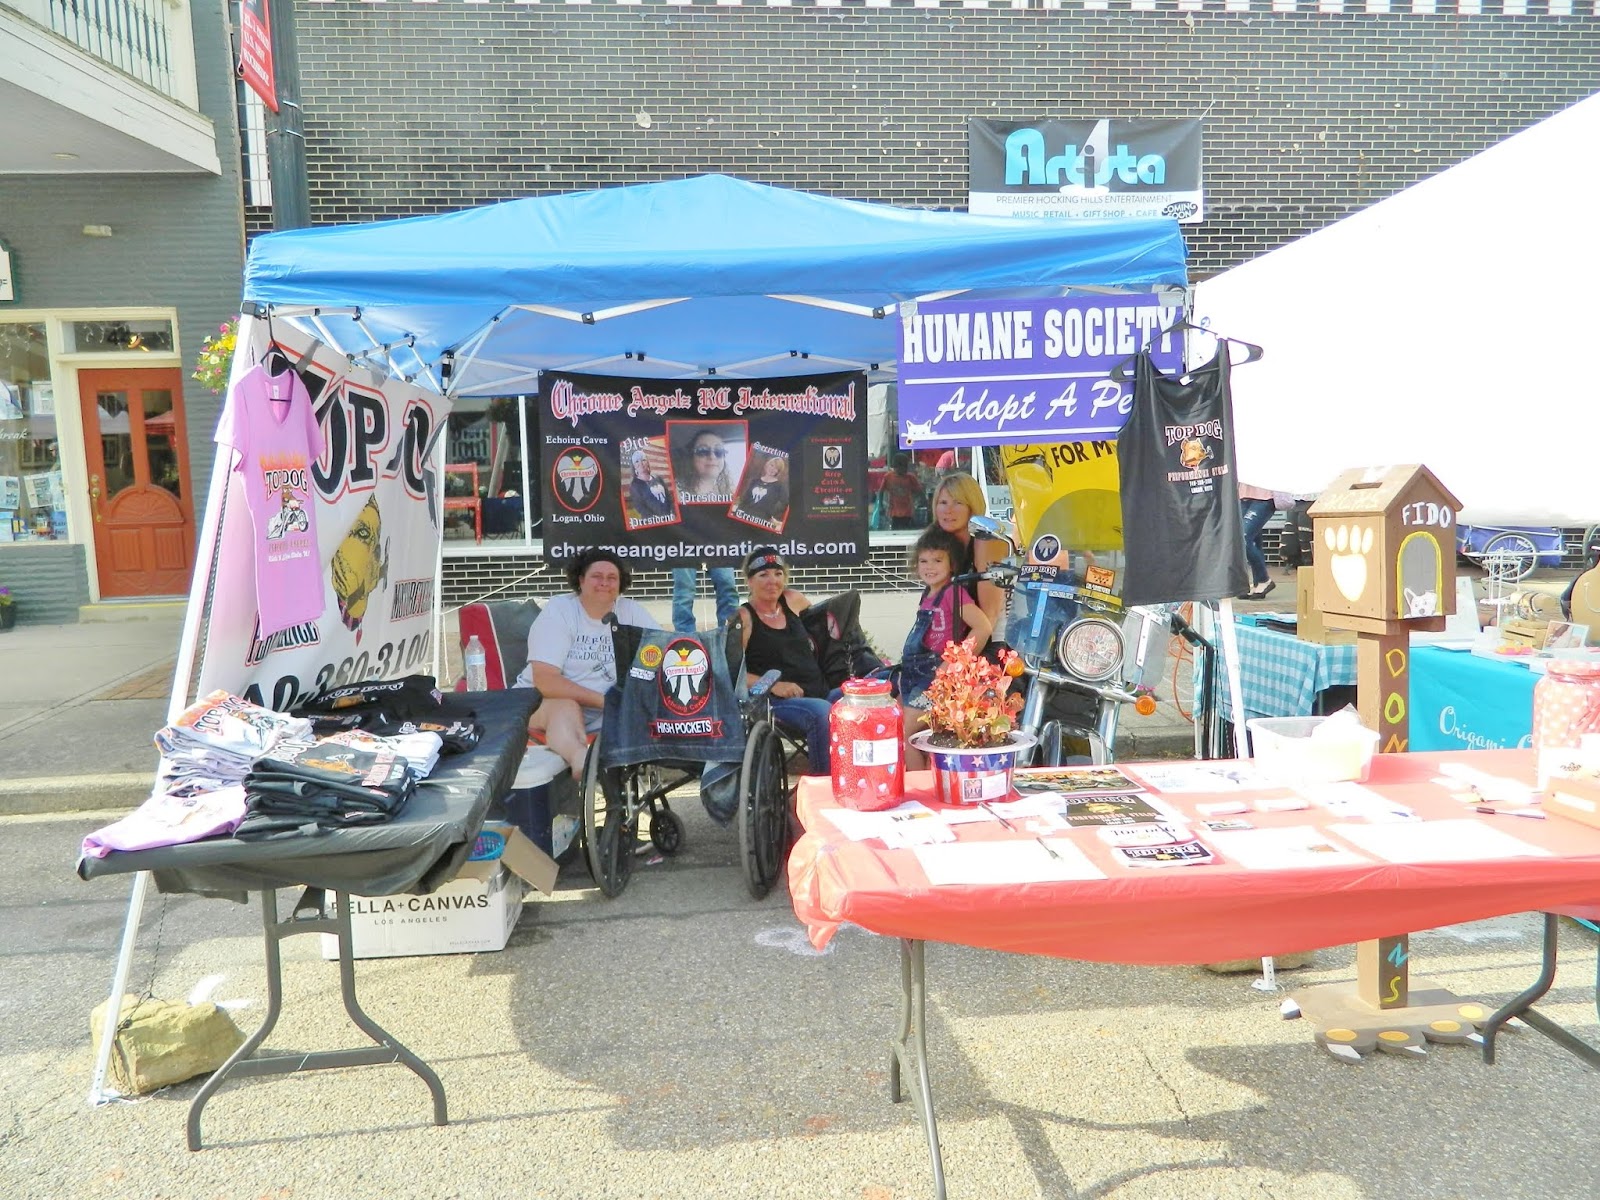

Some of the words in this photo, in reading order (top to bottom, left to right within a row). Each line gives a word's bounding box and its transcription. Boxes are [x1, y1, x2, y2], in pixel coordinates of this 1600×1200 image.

[1005, 128, 1165, 188] Artista
[996, 195, 1034, 204] PREMIER
[1036, 195, 1079, 204] HOCKING
[1081, 195, 1103, 203] HILLS
[1105, 194, 1172, 203] ENTERTAINMENT
[1163, 201, 1196, 213] COMING
[1012, 210, 1039, 218] MUSIC
[1044, 210, 1072, 218] RETAIL
[1083, 210, 1100, 218] GIFT
[1103, 210, 1125, 218] SHOP
[1136, 209, 1157, 217] CAFE
[903, 310, 1033, 364] HUMANE
[1044, 306, 1176, 359] SOCIETY
[551, 379, 624, 428] Chrome
[627, 386, 692, 418] Angelz
[697, 387, 731, 415] RC
[733, 381, 857, 422] International
[933, 386, 1036, 430] Adopt
[1045, 381, 1078, 420] A
[1091, 379, 1132, 418] Pe
[545, 435, 581, 445] Echoing
[582, 435, 608, 444] Caves
[1164, 425, 1193, 446] TOP
[1195, 419, 1223, 440] DOG
[623, 436, 650, 452] Vice
[1051, 442, 1089, 468] FOR
[1091, 440, 1115, 458] M
[282, 468, 309, 495] DOG
[679, 491, 733, 505] President
[991, 496, 1012, 506] Urb
[552, 513, 582, 524] Logan,
[583, 513, 605, 523] Ohio
[629, 511, 675, 529] President
[735, 509, 775, 529] Treasurer
[1401, 501, 1451, 529] FIDO
[657, 721, 675, 734] HIGH
[675, 719, 712, 734] POCKETS
[1439, 705, 1506, 750] Origami
[401, 916, 448, 924] ANGELES
